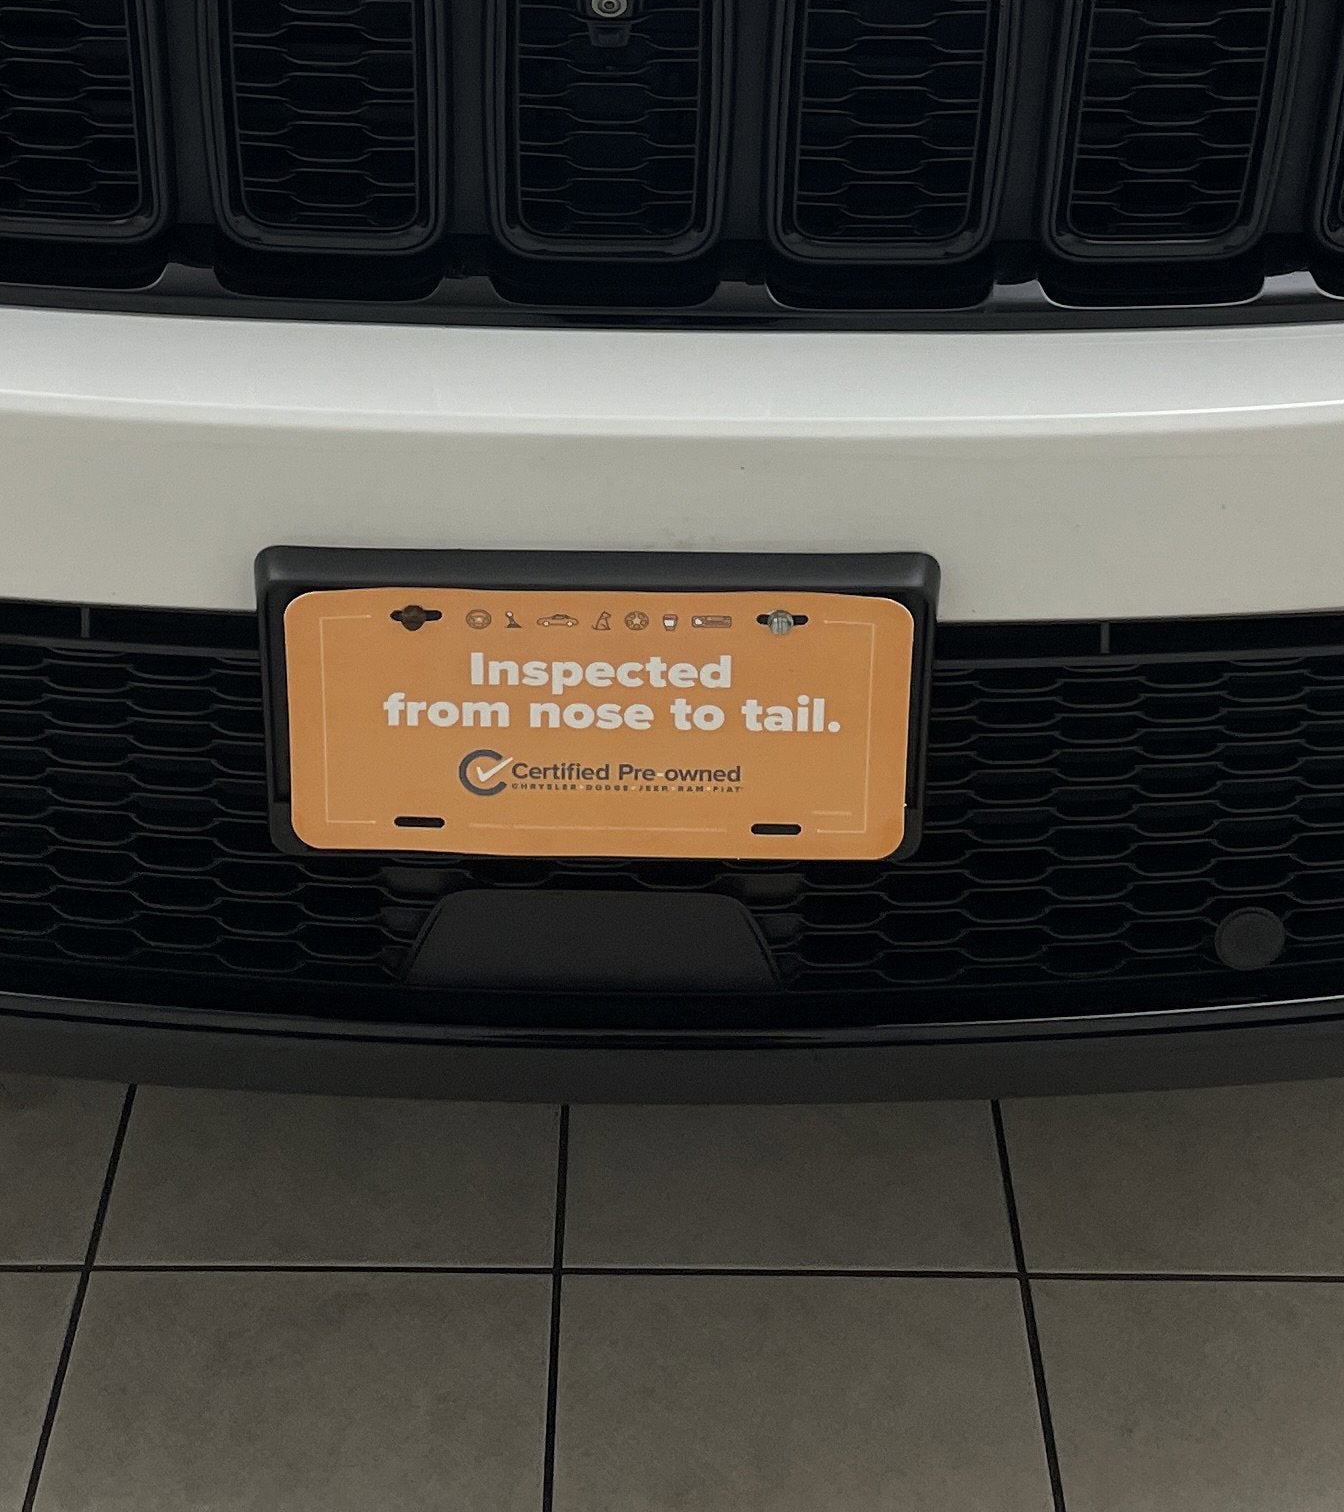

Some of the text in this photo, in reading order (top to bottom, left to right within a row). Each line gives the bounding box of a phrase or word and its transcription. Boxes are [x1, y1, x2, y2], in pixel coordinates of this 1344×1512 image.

[470, 651, 732, 695] Inspected
[383, 692, 841, 733] from nose to tail.
[511, 762, 742, 783] Certified Pre-owned
